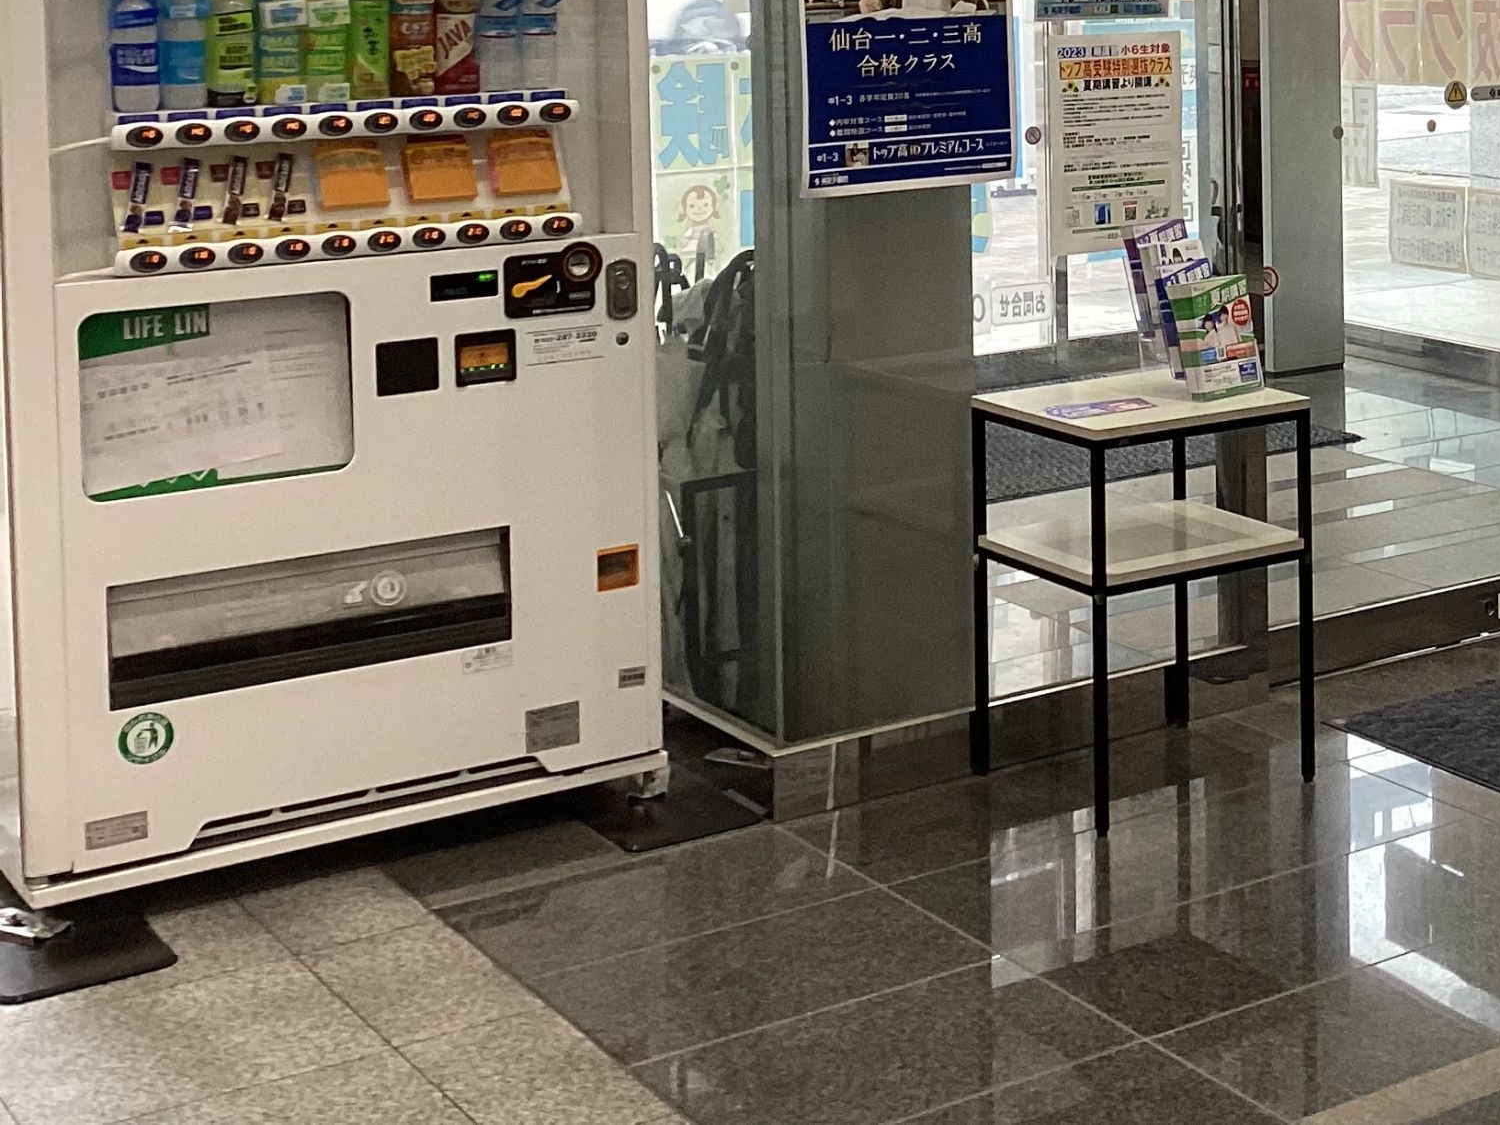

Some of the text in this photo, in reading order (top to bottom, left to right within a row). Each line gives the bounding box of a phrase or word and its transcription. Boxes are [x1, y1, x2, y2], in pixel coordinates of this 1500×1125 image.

[438, 18, 472, 60] JAVA
[828, 21, 983, 52] 仙台一・二・三高
[856, 52, 956, 78] 合格クラス
[1057, 46, 1086, 58] 2023
[122, 314, 165, 341] LIFE
